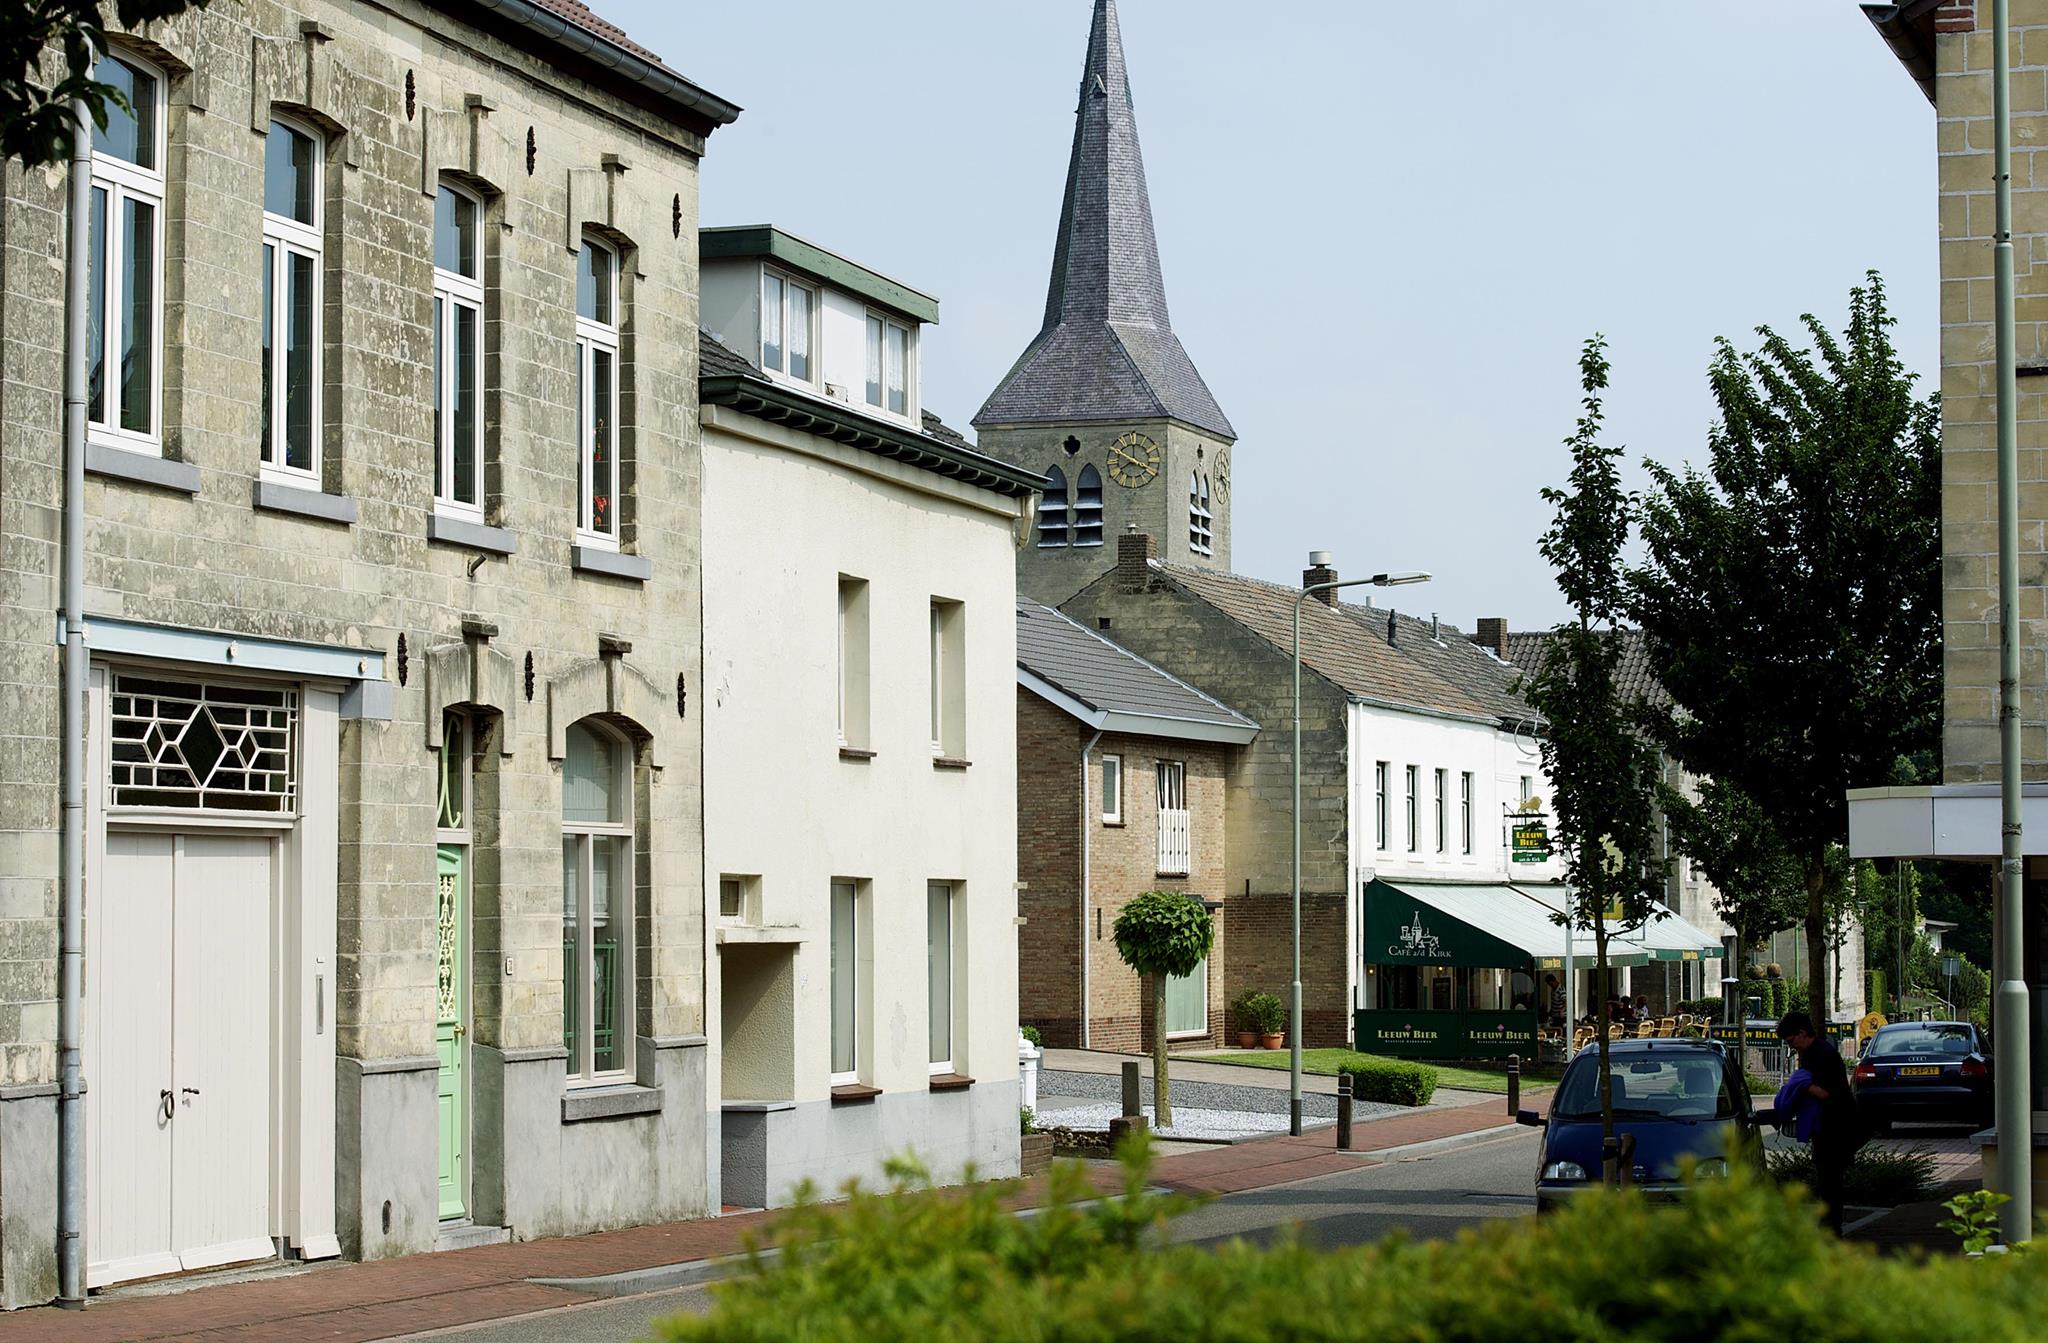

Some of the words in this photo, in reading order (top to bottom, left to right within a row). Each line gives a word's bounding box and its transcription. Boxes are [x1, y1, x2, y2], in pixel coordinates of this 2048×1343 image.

[1377, 1030, 1410, 1039] LEEUW
[1413, 1030, 1438, 1039] BIER
[1469, 1030, 1503, 1040] LEEUW
[1505, 1031, 1530, 1040] BIER
